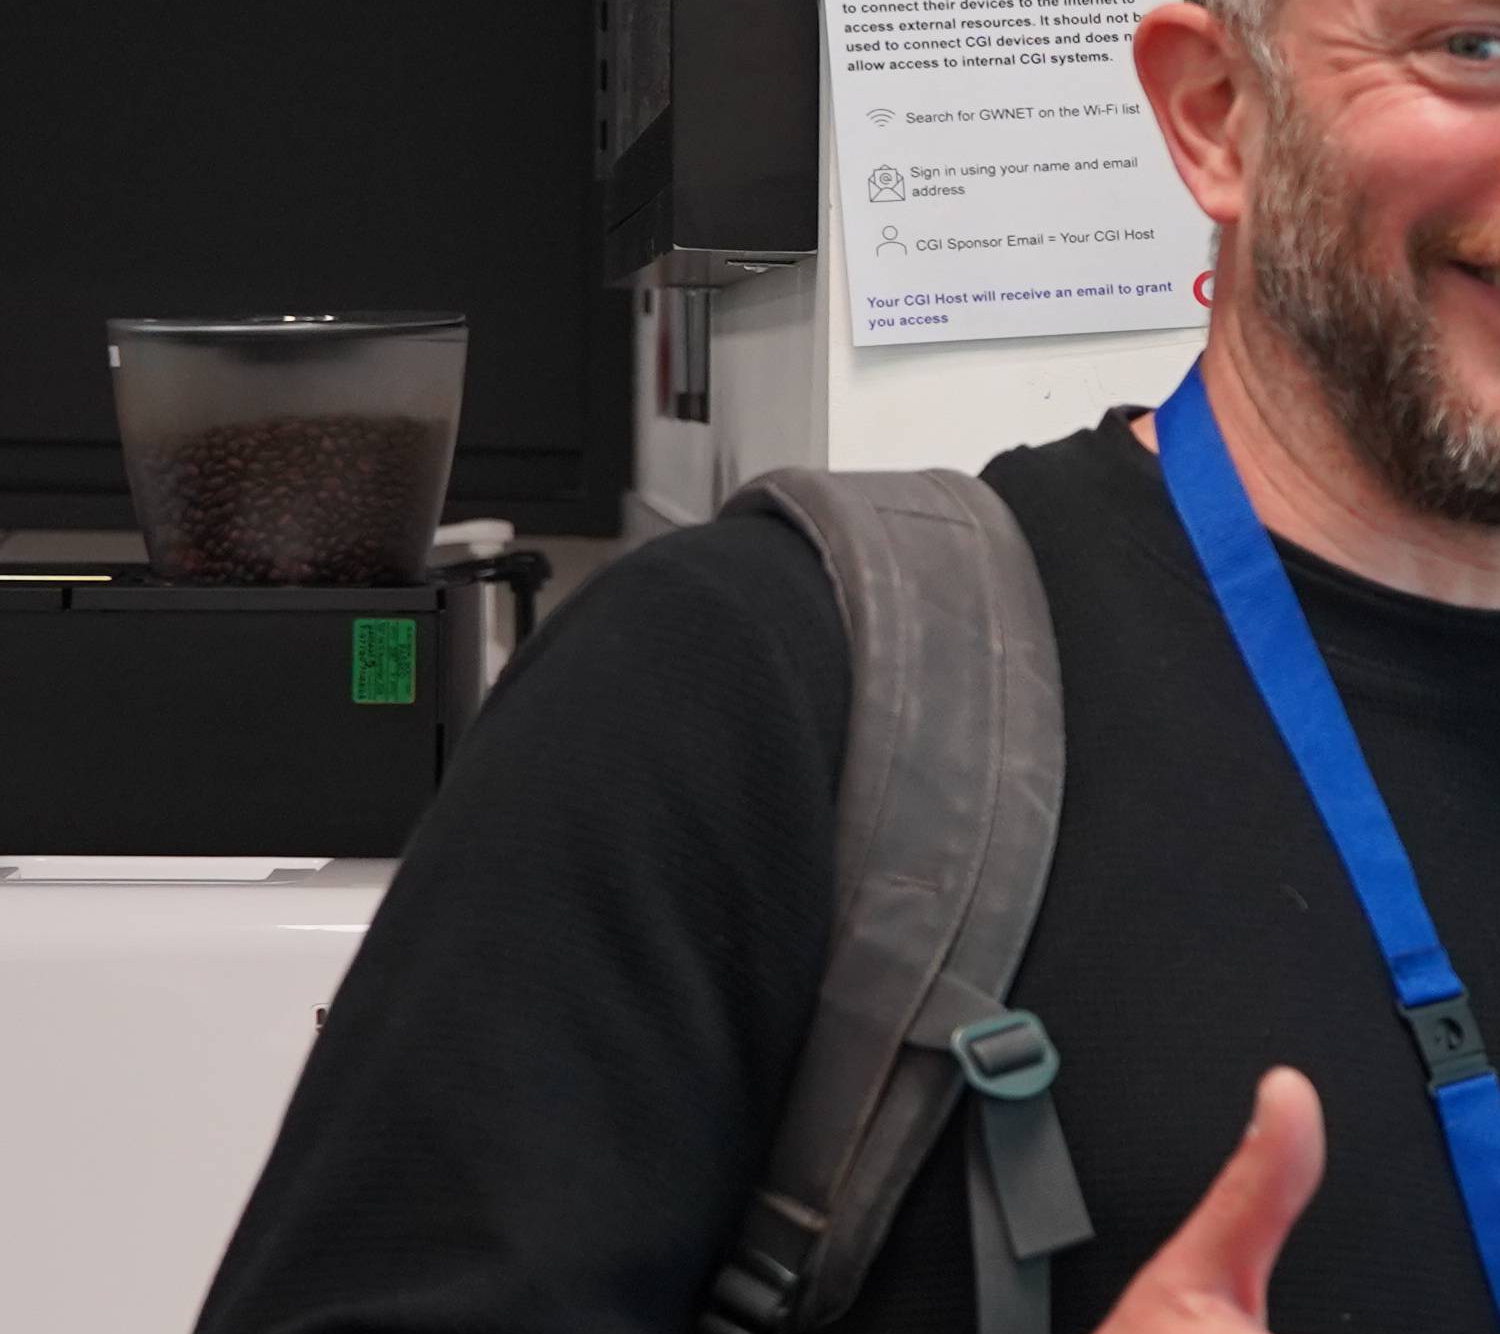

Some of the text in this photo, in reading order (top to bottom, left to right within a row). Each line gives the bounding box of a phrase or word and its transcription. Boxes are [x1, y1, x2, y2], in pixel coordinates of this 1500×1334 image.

[842, 3, 856, 14] to
[860, 0, 919, 13] connect
[844, 22, 894, 34] access
[898, 18, 956, 31] external
[960, 17, 1036, 29] resources.
[1039, 14, 1050, 26] It
[1052, 12, 1101, 26] should
[1106, 12, 1129, 24] not
[845, 39, 880, 52] used
[884, 40, 899, 51] to
[903, 37, 962, 51] connect
[965, 35, 991, 48] CGI
[995, 33, 1050, 47] devices
[1054, 32, 1080, 44] and
[1084, 30, 1119, 43] does
[846, 51, 1113, 71] allow access to internal CGI systems.
[905, 102, 1140, 124] Search for GWNET on the Wi-Fi list
[909, 156, 1138, 181] Sign in using your name and email
[911, 183, 965, 197] address
[915, 238, 942, 251] CGI
[946, 235, 1003, 252] Sponsor
[1006, 233, 1043, 246] Email
[1059, 231, 1090, 244] Your
[1093, 229, 1120, 242] CGI
[1124, 228, 1155, 240] Host
[866, 281, 1173, 308] Your CGI Host will receive an email to grant
[868, 313, 948, 330] you access
